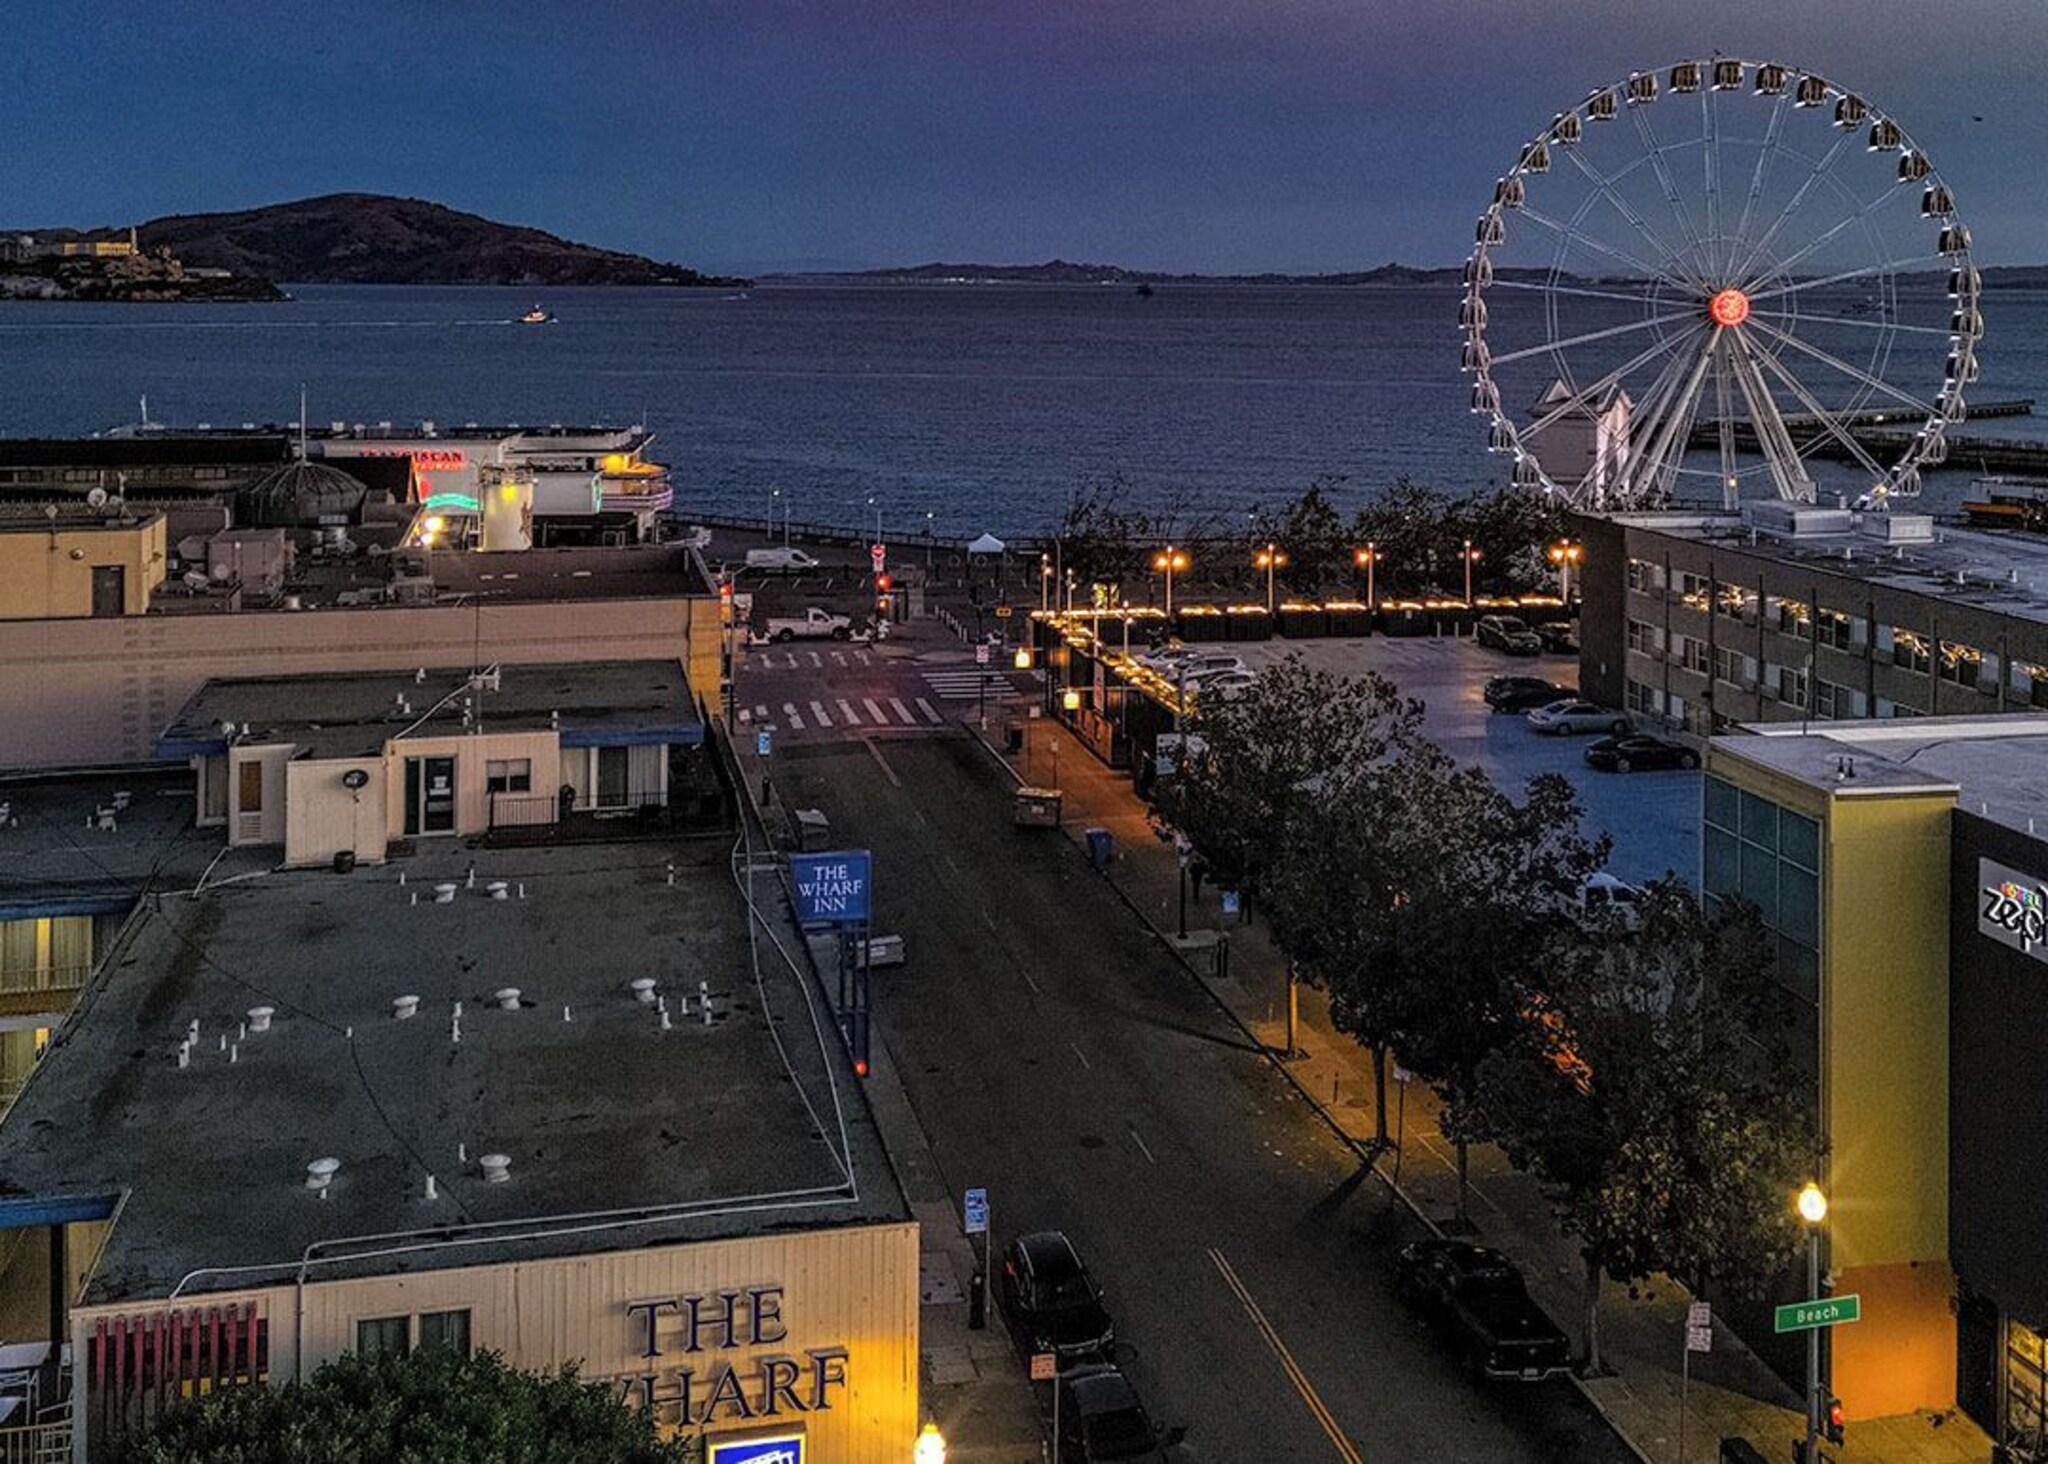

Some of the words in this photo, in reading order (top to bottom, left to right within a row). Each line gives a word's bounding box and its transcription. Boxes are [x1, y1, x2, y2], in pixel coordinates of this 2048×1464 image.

[812, 864, 848, 881] THE
[798, 879, 863, 897] WHARF
[814, 896, 847, 913] INN
[627, 1286, 788, 1359] THE
[1797, 1305, 1839, 1323] Beach
